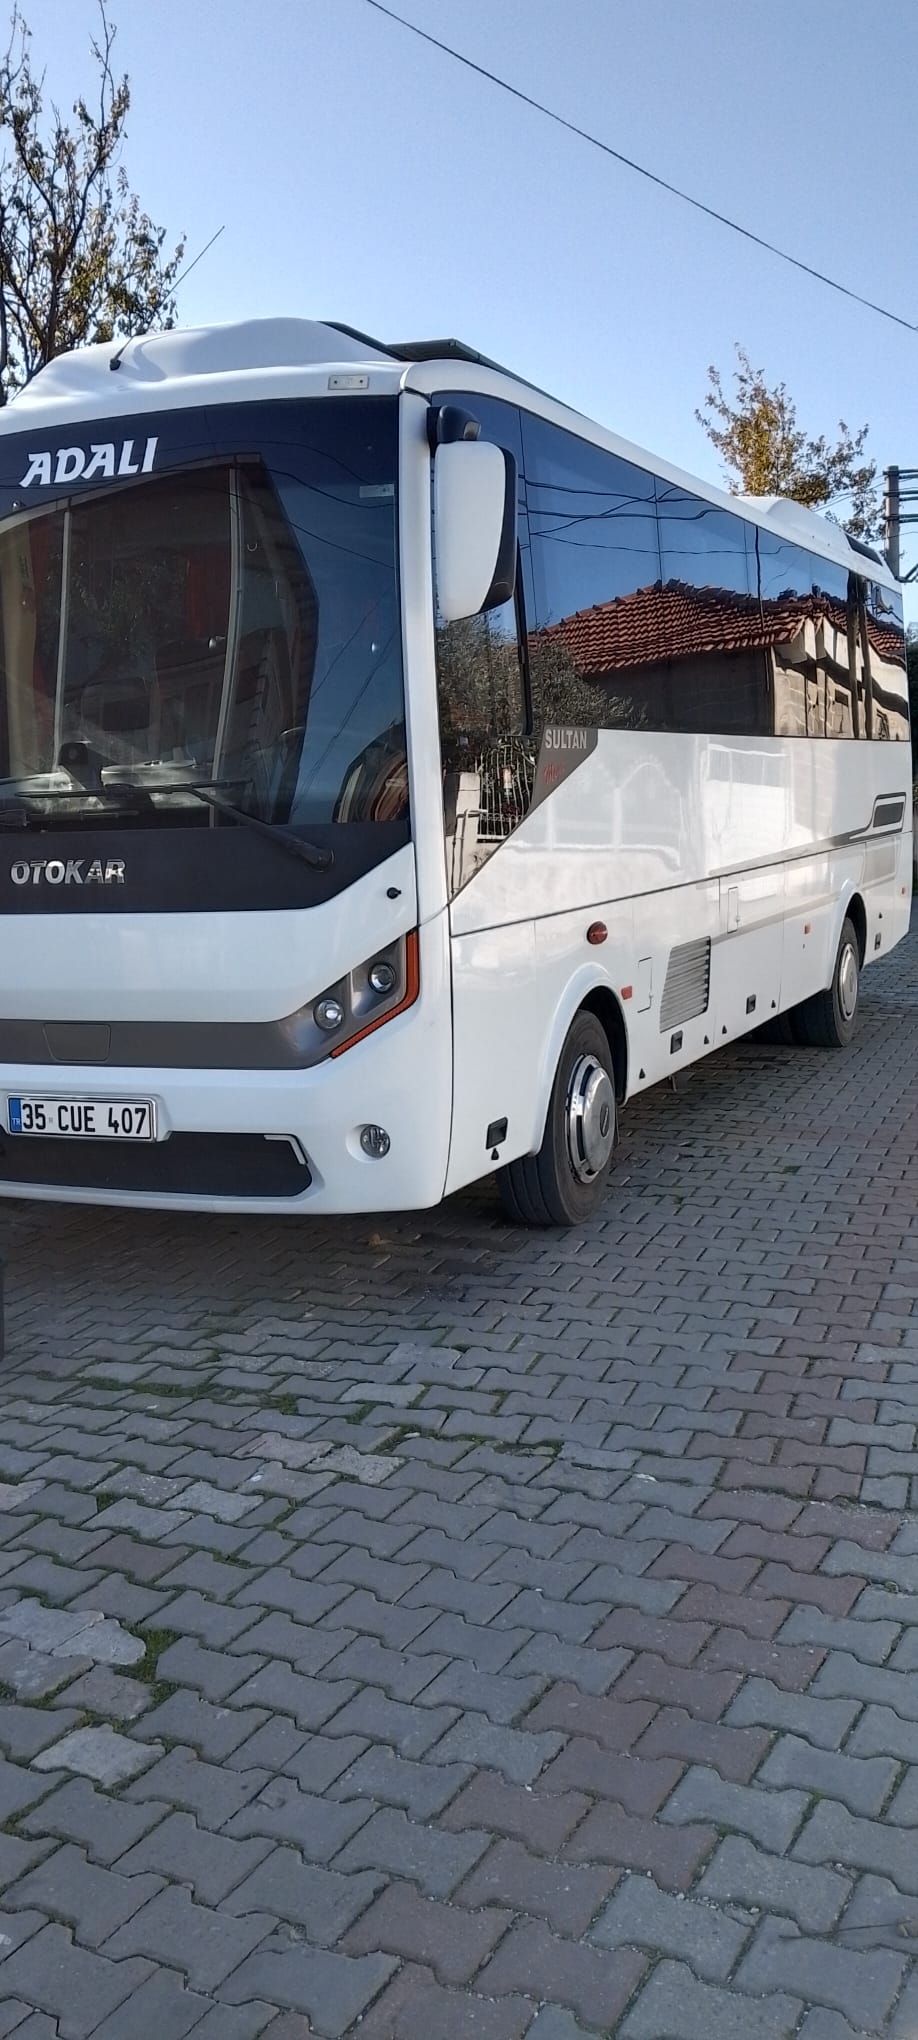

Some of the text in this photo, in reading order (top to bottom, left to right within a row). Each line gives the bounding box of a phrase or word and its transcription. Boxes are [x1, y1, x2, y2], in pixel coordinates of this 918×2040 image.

[19, 437, 159, 488] ADALI
[545, 728, 587, 749] SULTAN
[10, 859, 126, 884] OTOKAR
[11, 1117, 21, 1126] TR
[22, 1103, 147, 1135] 35 CUE 407
